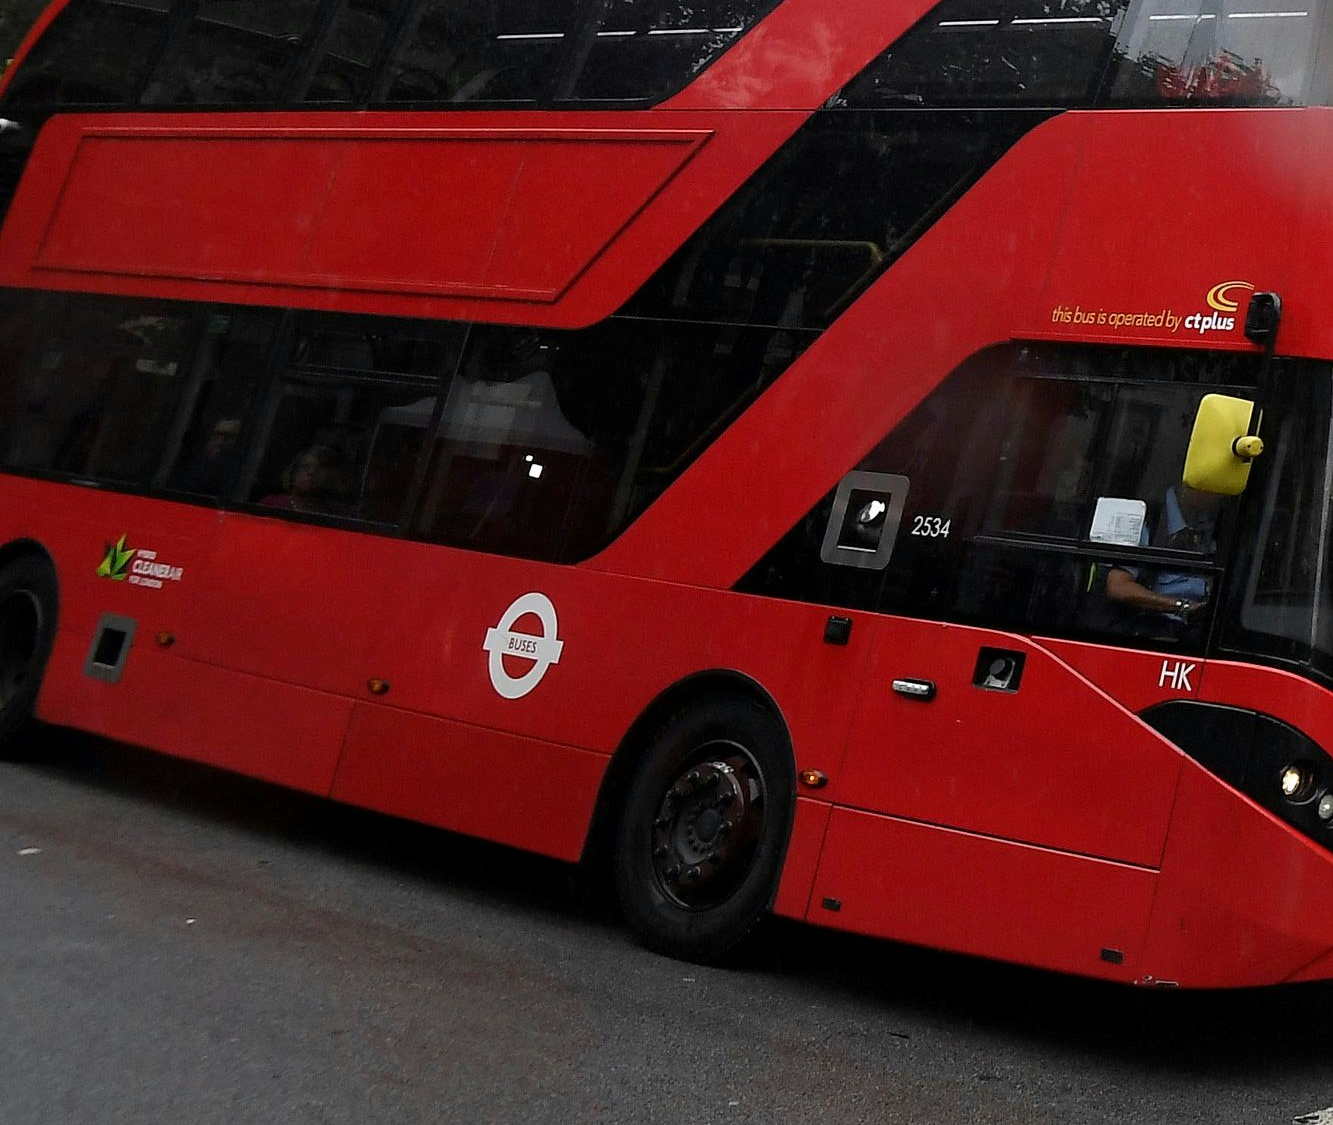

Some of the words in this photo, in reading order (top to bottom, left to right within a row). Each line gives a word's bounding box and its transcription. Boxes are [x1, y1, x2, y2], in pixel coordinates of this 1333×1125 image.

[1052, 305, 1072, 324] this
[1073, 306, 1095, 325] bus
[1097, 308, 1107, 324] is
[1108, 310, 1166, 330] operated
[1165, 311, 1182, 333] by
[1184, 312, 1235, 334] ctplus
[911, 515, 951, 538] 2534
[508, 637, 538, 654] BUSES
[1158, 660, 1196, 692] HK
